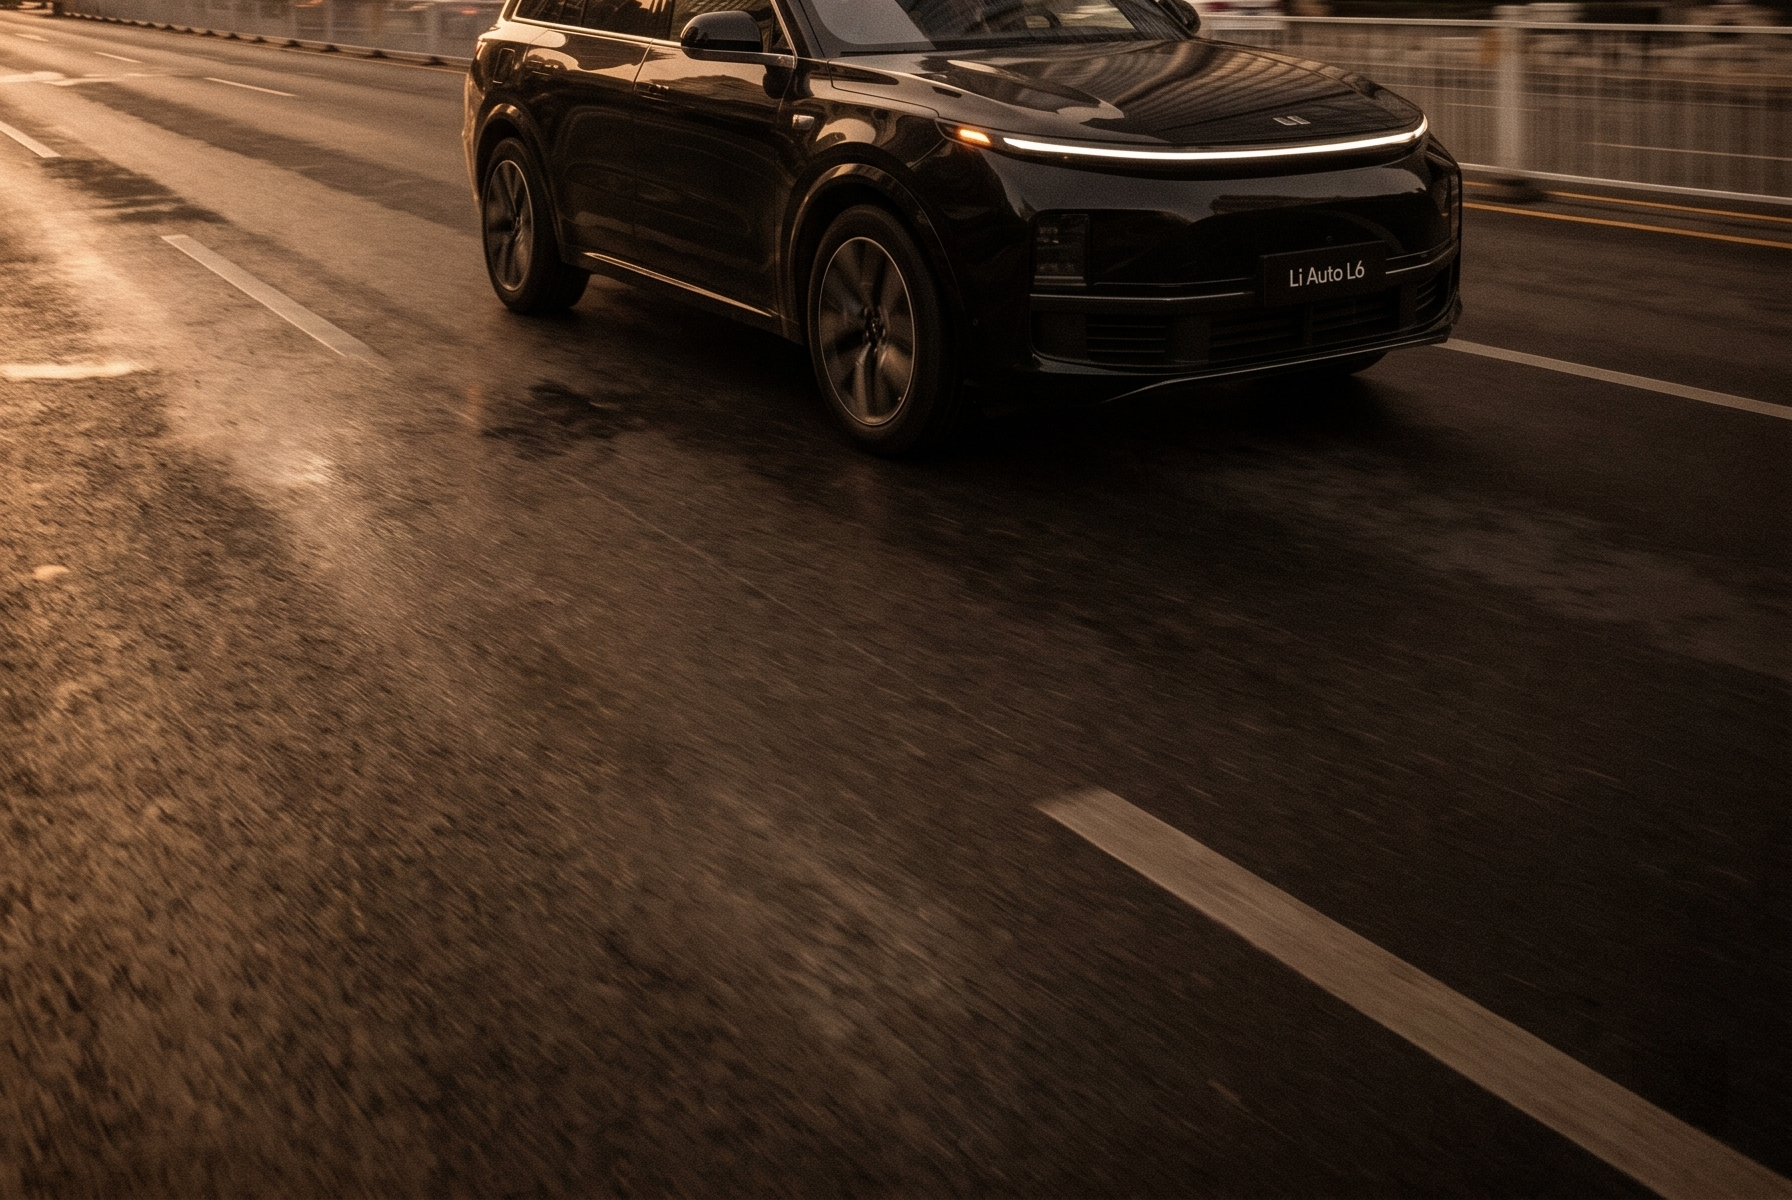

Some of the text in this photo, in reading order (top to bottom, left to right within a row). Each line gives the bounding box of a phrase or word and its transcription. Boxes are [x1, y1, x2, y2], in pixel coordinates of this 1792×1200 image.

[1289, 260, 1365, 287] Li Auto L6
